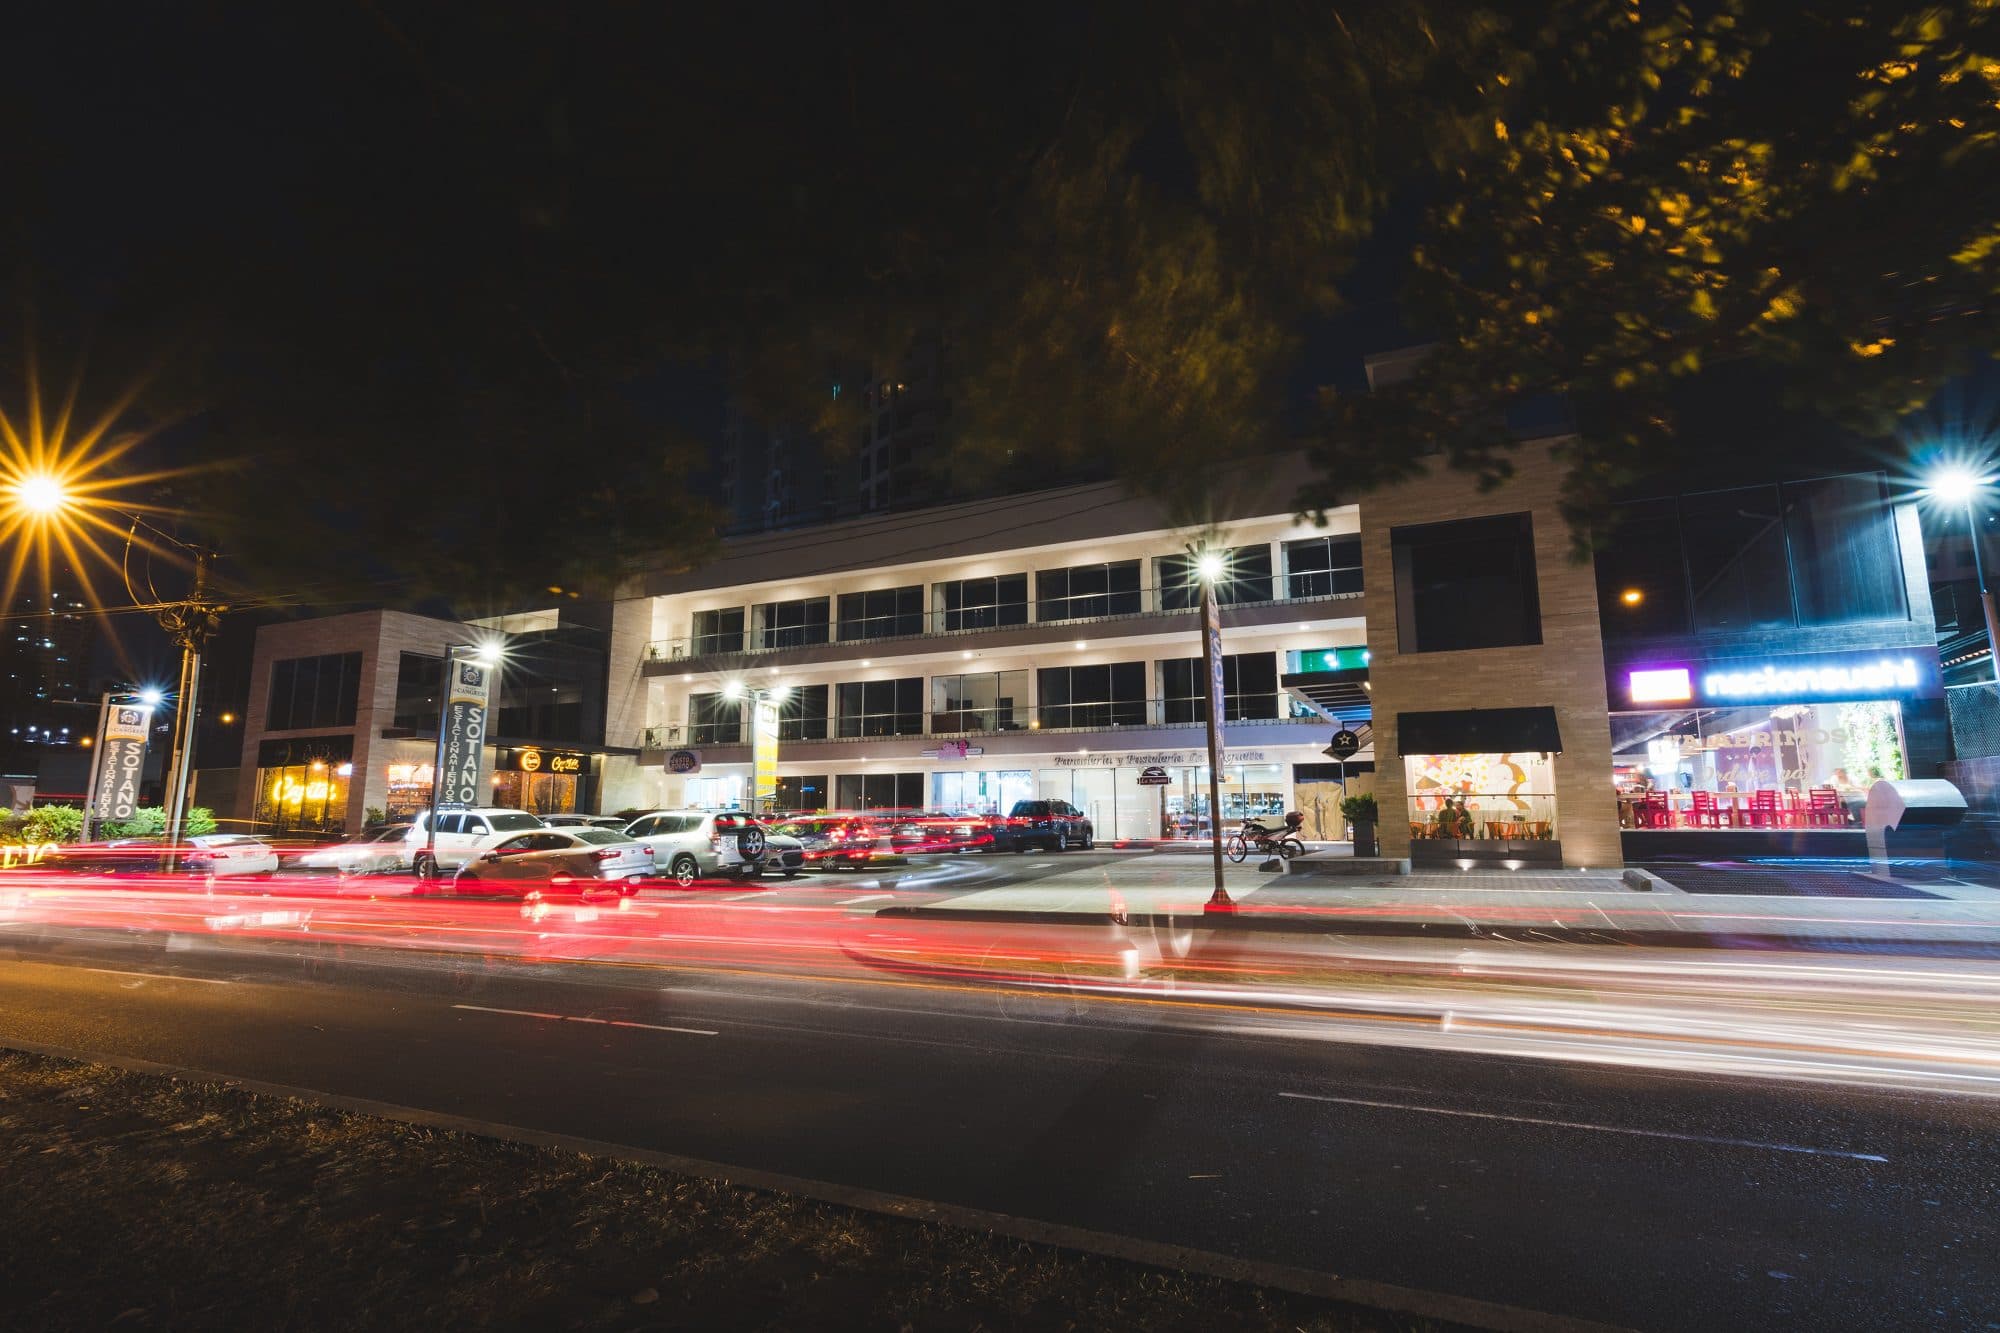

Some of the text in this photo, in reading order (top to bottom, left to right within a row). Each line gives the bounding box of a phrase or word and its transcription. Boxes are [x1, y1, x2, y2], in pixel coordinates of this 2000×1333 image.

[99, 741, 121, 818] ESTACIONAMIENTOS
[115, 742, 142, 818] SOTANO
[446, 705, 463, 803] ESTACIONAMIENTOS
[460, 707, 482, 803] SOTANO
